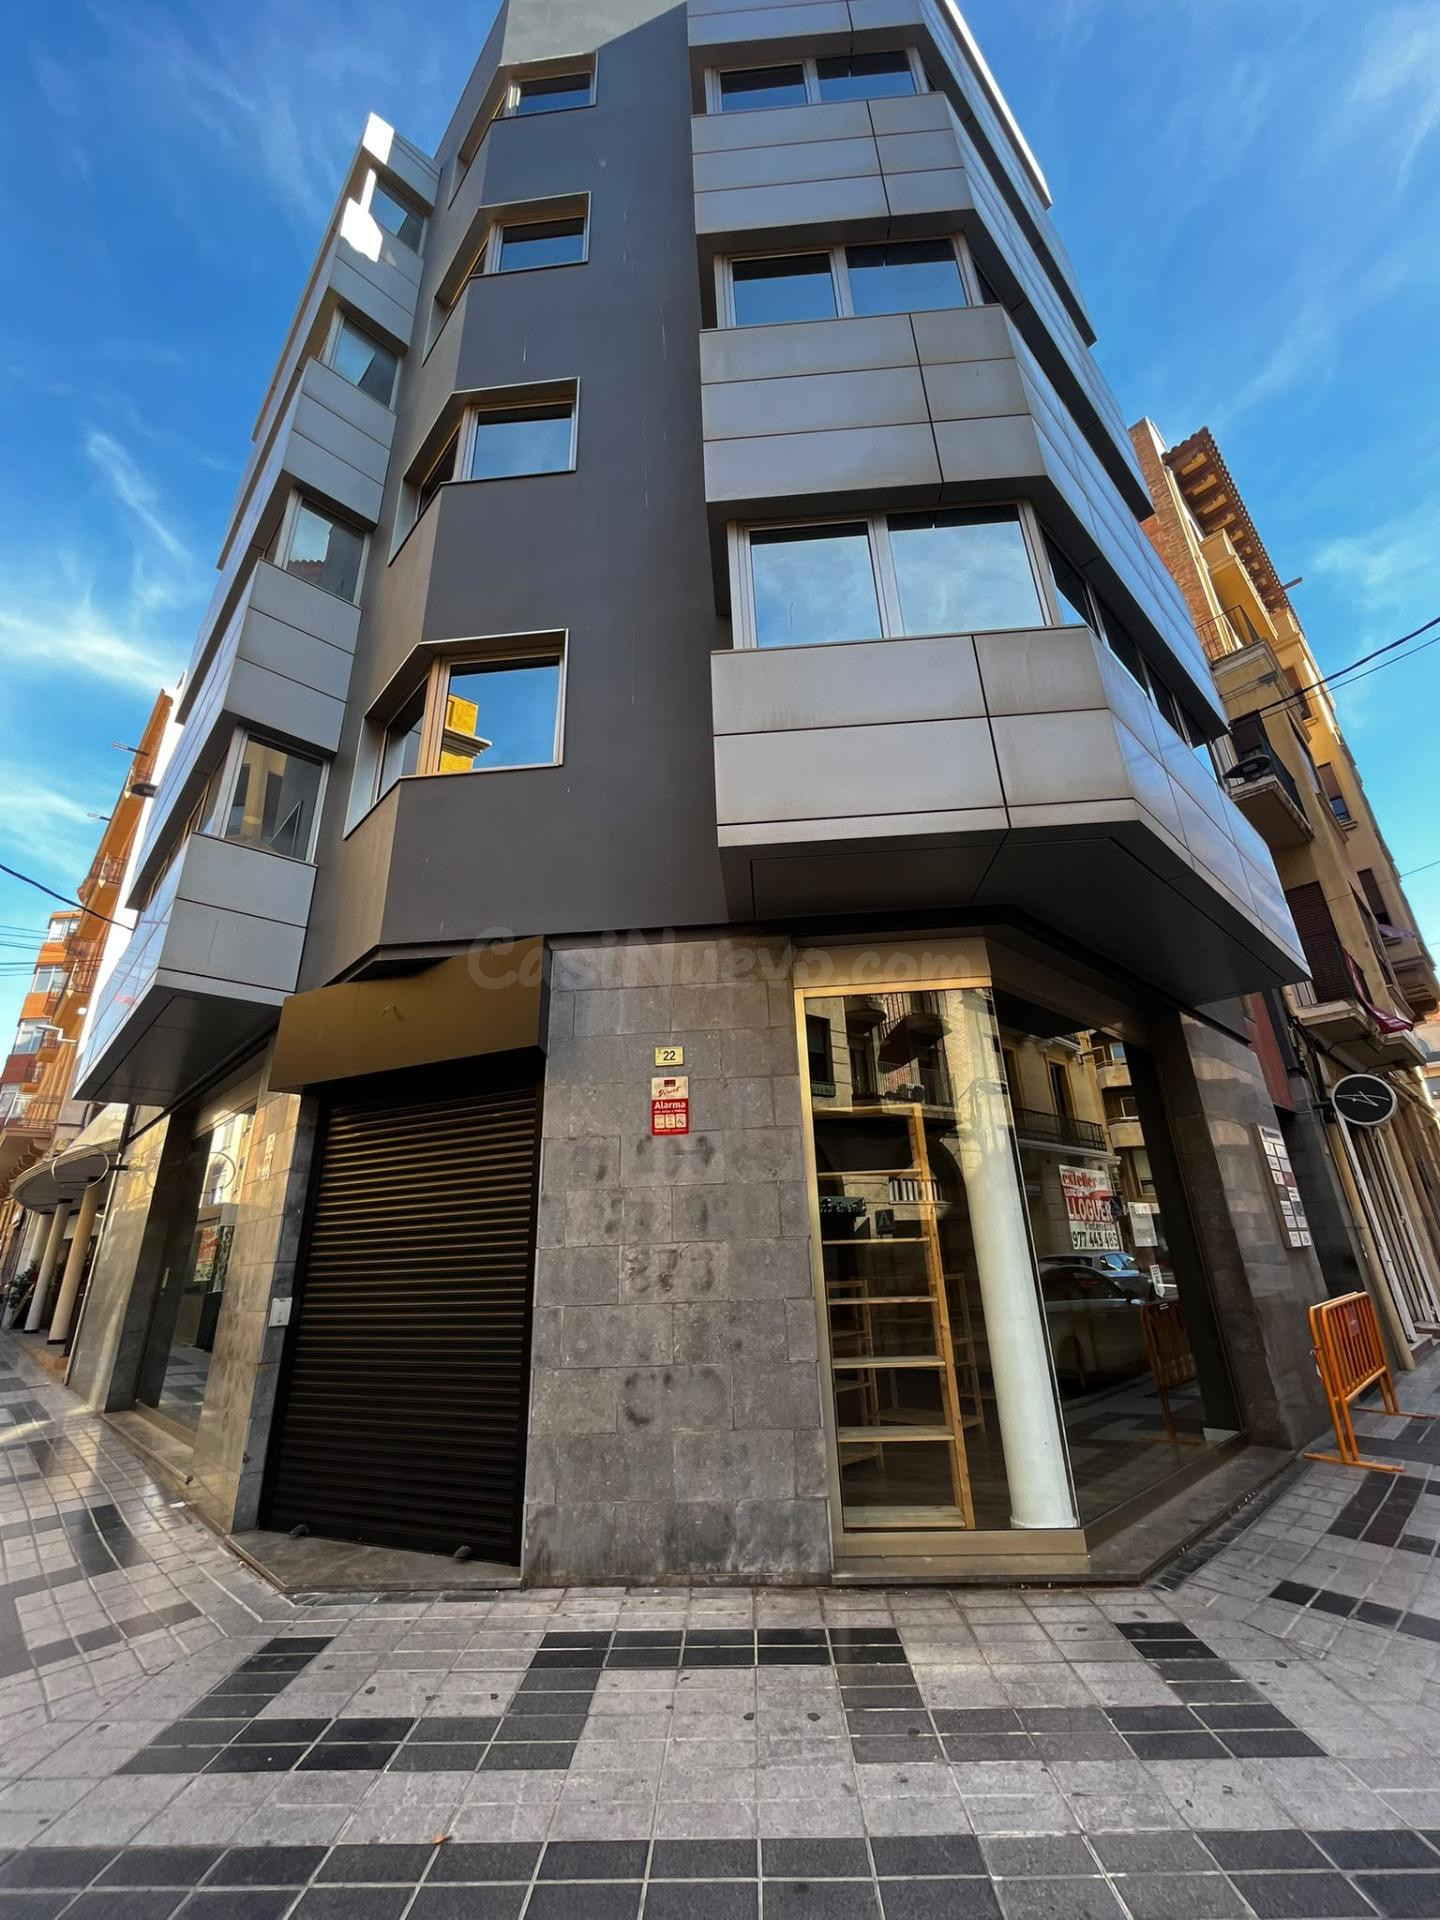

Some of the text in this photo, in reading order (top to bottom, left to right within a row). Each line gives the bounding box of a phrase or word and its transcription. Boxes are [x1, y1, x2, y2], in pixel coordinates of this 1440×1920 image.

[663, 1050, 676, 1061] 22
[654, 1101, 686, 1110] Alarma
[1065, 1197, 1114, 1222] LLOGUER
[1072, 1230, 1087, 1248] 977
